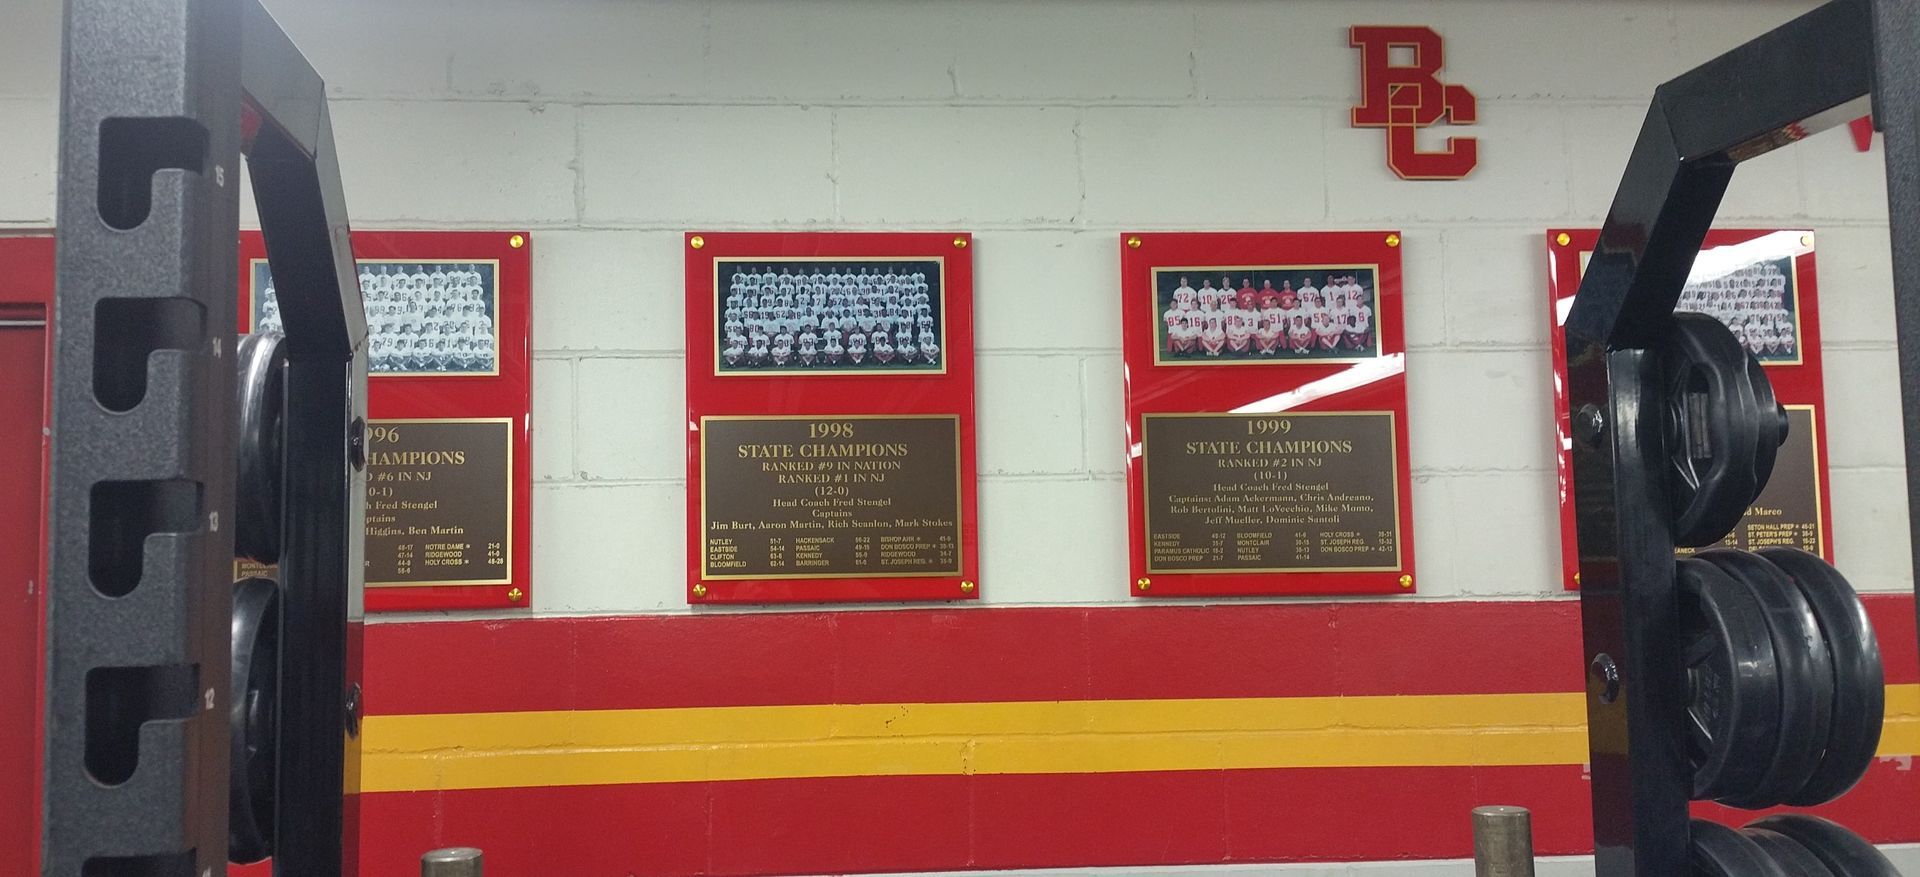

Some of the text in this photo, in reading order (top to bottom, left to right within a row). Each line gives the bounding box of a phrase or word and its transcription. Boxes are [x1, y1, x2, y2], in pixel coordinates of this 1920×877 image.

[808, 423, 854, 438] 1998
[1246, 420, 1292, 435] 1999
[367, 426, 399, 442] 96
[738, 444, 908, 458] STATE CHAMPIONS
[1187, 440, 1352, 455] STATE CHAMPIONS
[367, 452, 465, 466] HAMPIONS
[1219, 458, 1322, 468] RANKED #2 IN NJ
[762, 461, 901, 471] RANKED #9 IN NATION
[377, 472, 394, 481] #6
[398, 472, 412, 481] IN
[416, 472, 432, 481] NJ
[778, 474, 884, 483] RANKED #1 IN NJ
[1254, 471, 1287, 481] (10-1)
[815, 486, 849, 496] (12-0)
[1213, 482, 1329, 491] Head Coach Fred Stengel
[369, 487, 393, 497] 0-1)
[773, 499, 797, 507] Head
[833, 498, 854, 506] Fred
[857, 498, 891, 507] Stengel
[1169, 495, 1211, 504] Captains:
[1214, 494, 1240, 502] Adam
[1243, 494, 1297, 502] Ackermann,
[1328, 493, 1374, 501] Andreano,
[376, 500, 398, 510] Fred
[401, 500, 438, 510] Stengel
[1171, 506, 1188, 514] Rob
[1192, 506, 1234, 514] Bertolini,
[1238, 505, 1258, 513] Matt
[1316, 504, 1338, 512] Mike
[812, 509, 852, 518] Captains
[366, 514, 396, 524] ptains
[1205, 516, 1222, 524] Jeff
[1225, 516, 1263, 524] Mueller,
[1308, 515, 1339, 523] Santoli
[711, 521, 728, 530] Jim
[732, 521, 755, 530] Burt,
[758, 521, 786, 529] Aaron
[790, 520, 824, 529] Martin,
[828, 520, 848, 528] Rich
[852, 520, 892, 528] Scanlon,
[895, 519, 919, 527] Mark
[408, 526, 428, 535] Ben
[431, 526, 464, 535] Martin
